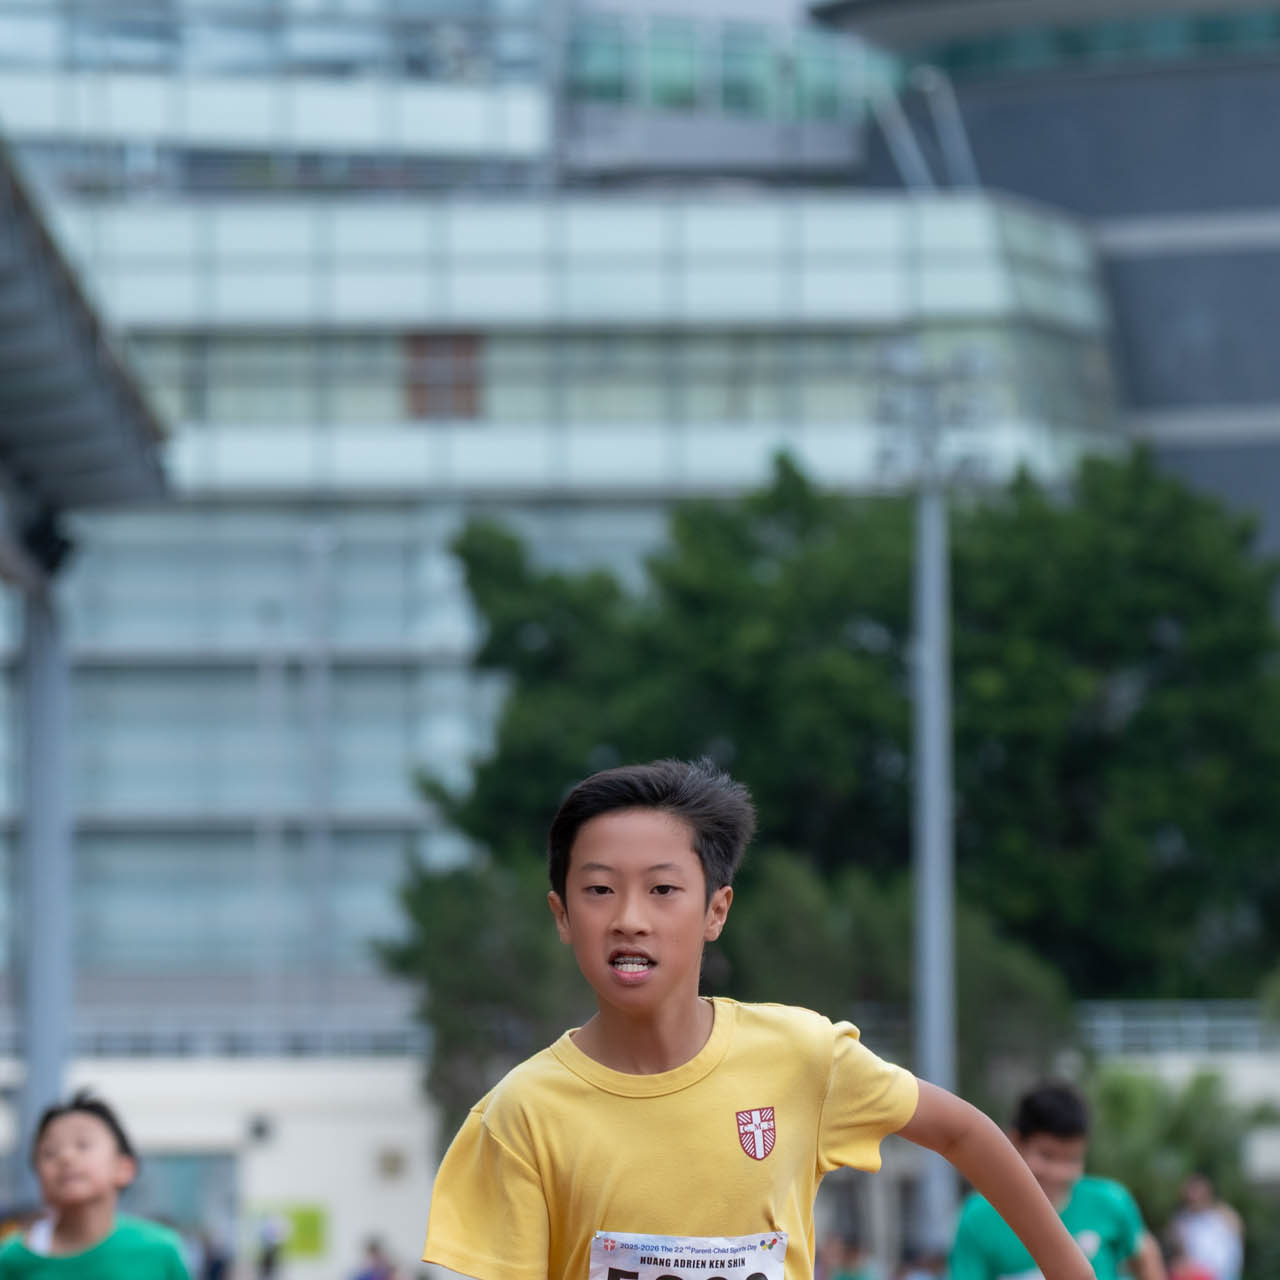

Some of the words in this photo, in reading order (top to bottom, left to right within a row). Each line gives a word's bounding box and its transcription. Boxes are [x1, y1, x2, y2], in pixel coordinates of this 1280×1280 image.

[661, 1245, 673, 1253] The
[747, 1244, 757, 1252] Day
[640, 1256, 671, 1267] HUANG
[673, 1258, 707, 1269] ADRIEN
[709, 1259, 725, 1269] KEN
